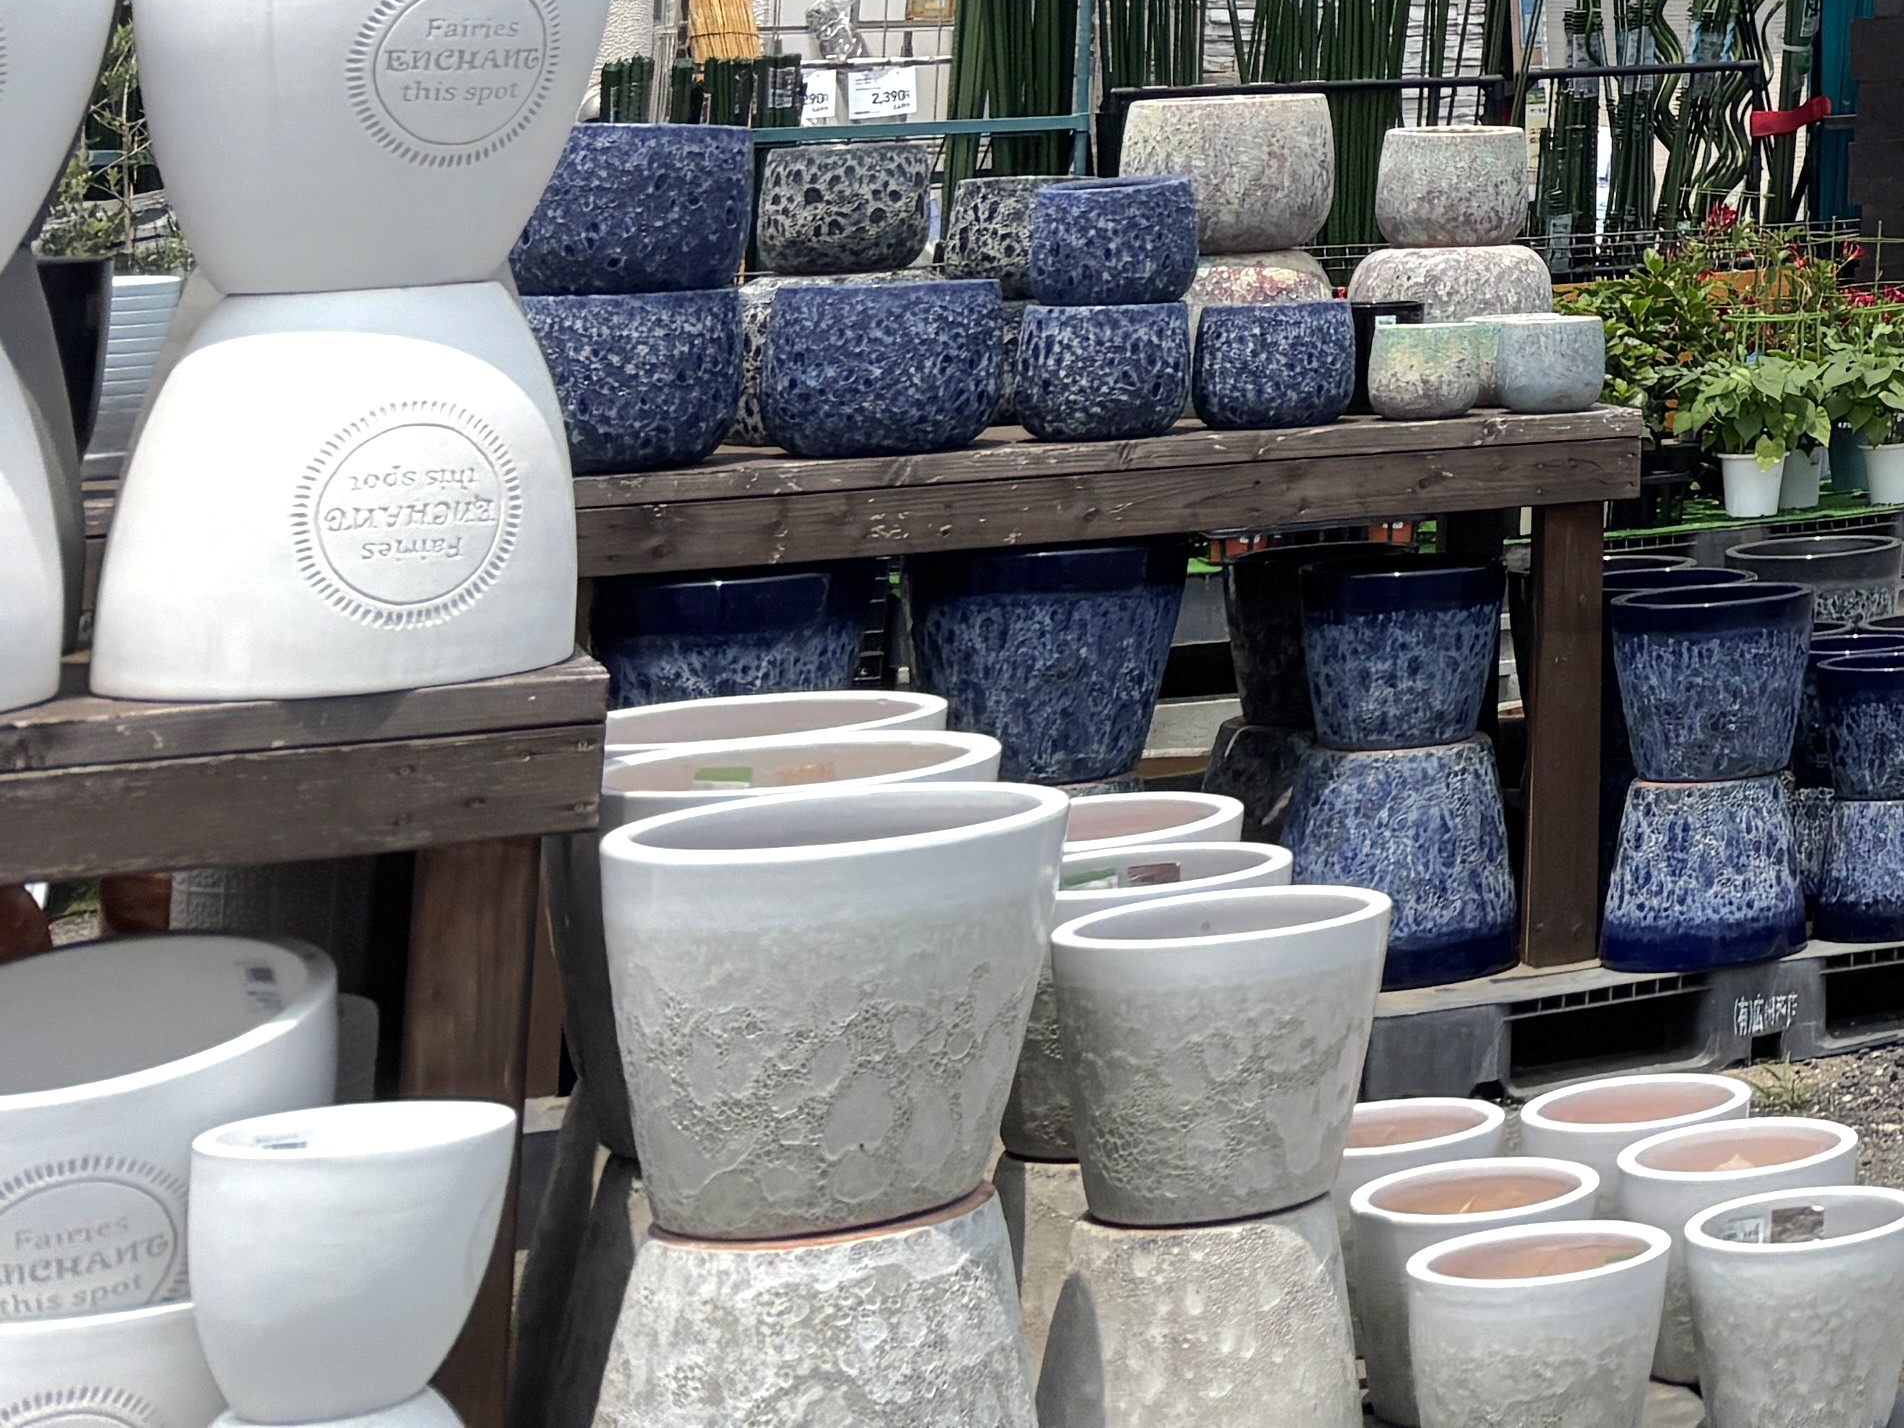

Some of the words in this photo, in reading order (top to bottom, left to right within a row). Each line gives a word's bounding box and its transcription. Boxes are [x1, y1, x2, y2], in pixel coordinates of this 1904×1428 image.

[424, 15, 520, 42] Fairies
[385, 44, 541, 75] ENCHANT
[400, 77, 462, 104] this
[465, 77, 519, 109] spot
[348, 464, 417, 492] spot
[426, 465, 480, 488] this
[360, 535, 463, 564] Fairies
[13, 1214, 130, 1250] Fairies
[72, 1273, 144, 1312] spot
